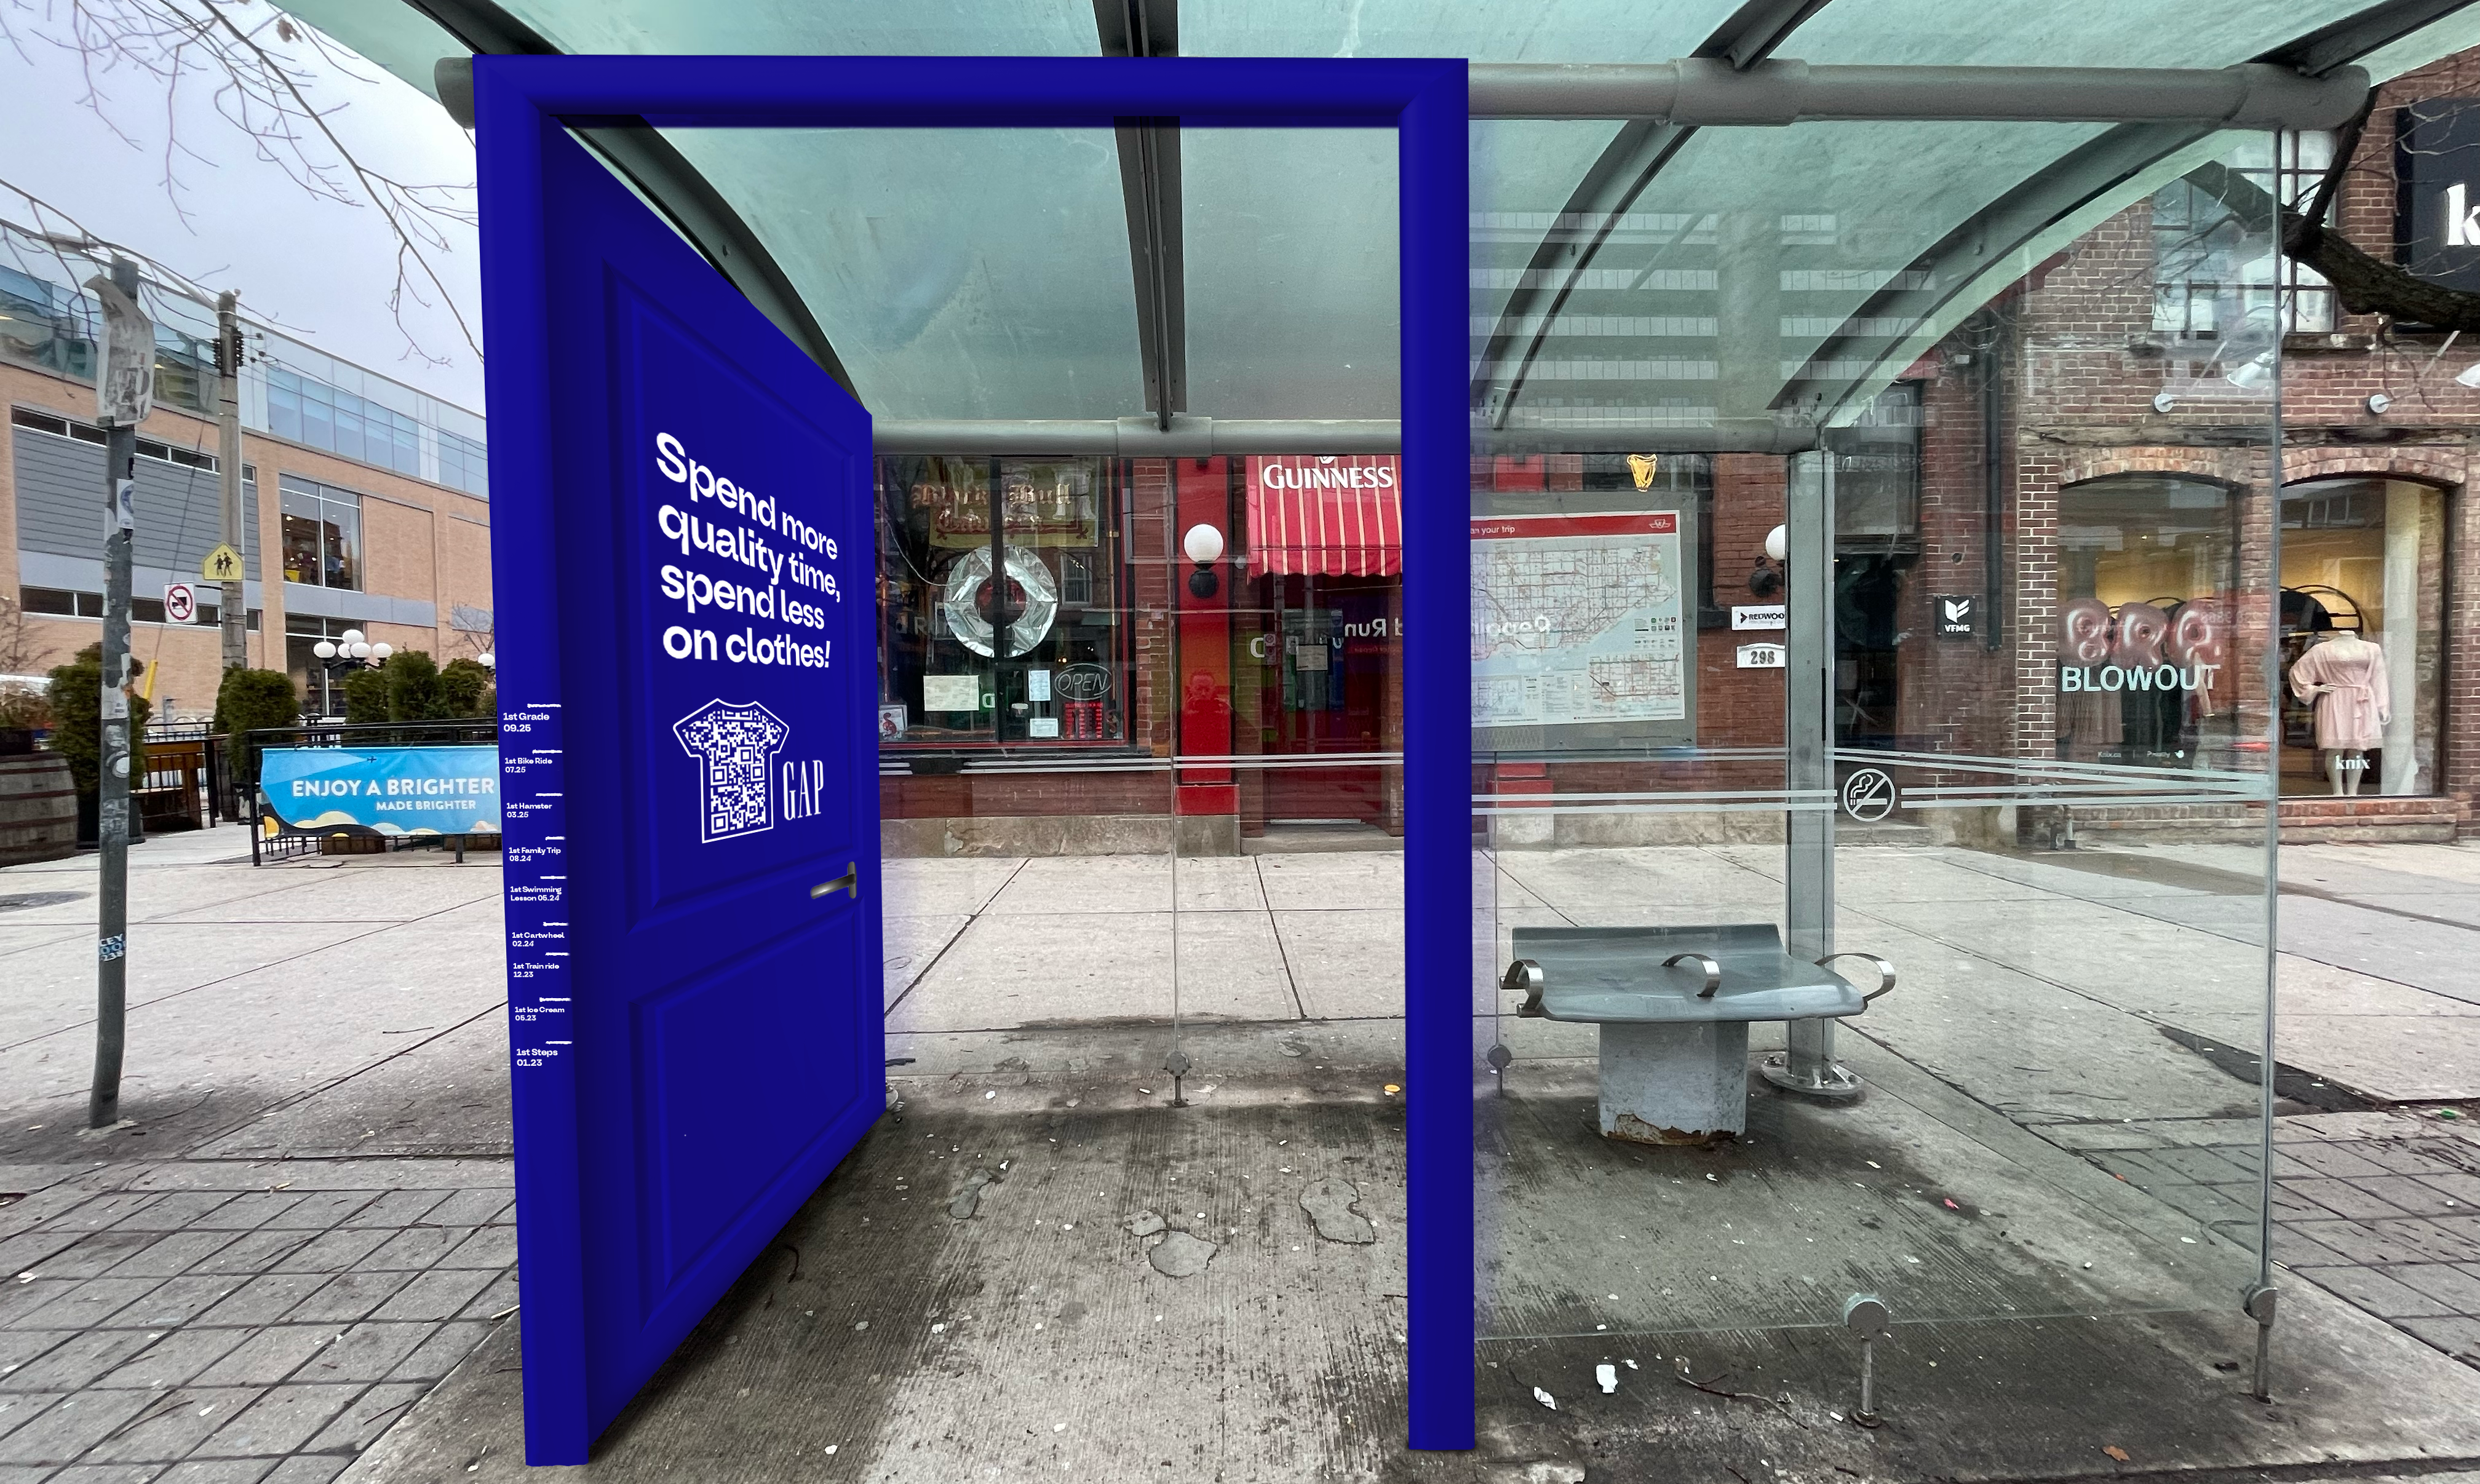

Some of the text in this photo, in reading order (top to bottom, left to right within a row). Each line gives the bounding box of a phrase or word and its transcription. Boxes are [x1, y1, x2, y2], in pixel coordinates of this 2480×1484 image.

[1263, 464, 1394, 489] GUINNESS
[657, 432, 837, 560] Spend more
[1481, 527, 1500, 536] your
[1502, 525, 1515, 534] trip
[659, 505, 840, 603] quality time,
[661, 565, 824, 629] spend less
[663, 626, 830, 667] on clothes!
[1751, 651, 1775, 664] 298
[1058, 672, 1108, 692] OPEN
[2062, 664, 2221, 692] BLOWOUT
[504, 712, 550, 721] 1st Grade
[503, 724, 531, 732] 09.25
[2335, 755, 2371, 769] knix
[293, 777, 495, 797] ENJOY A BRIGHTER
[783, 760, 824, 820] GAP
[376, 800, 476, 811] MADE BRIGHTER
[521, 847, 546, 855] Family
[546, 847, 561, 855] Trip
[522, 886, 562, 895] Swimming
[531, 1048, 558, 1058] Steps
